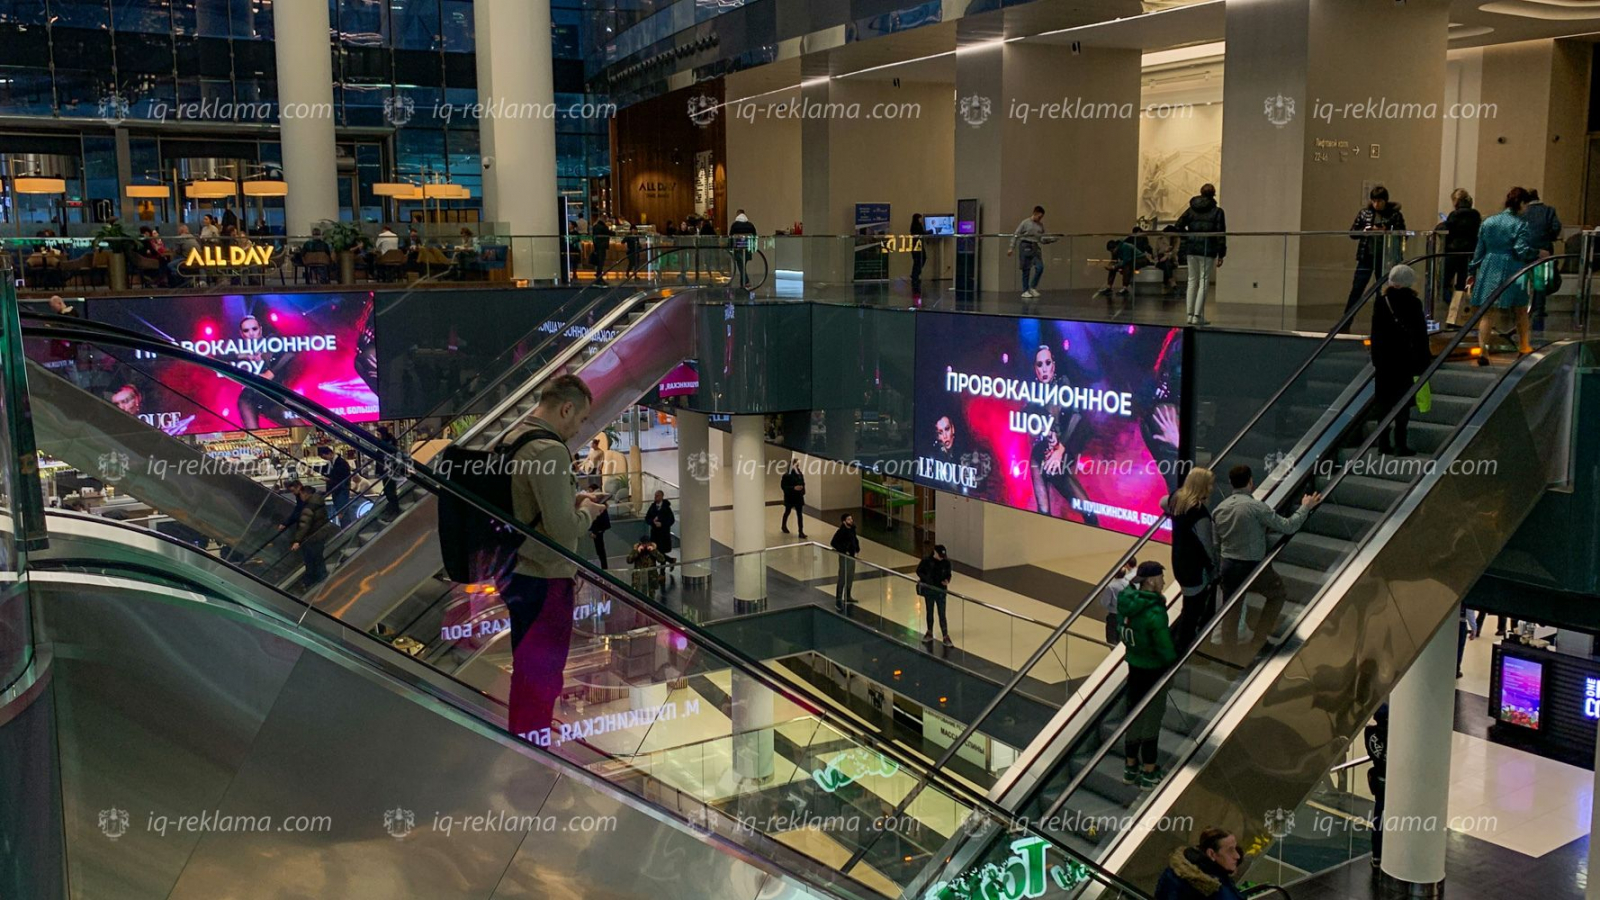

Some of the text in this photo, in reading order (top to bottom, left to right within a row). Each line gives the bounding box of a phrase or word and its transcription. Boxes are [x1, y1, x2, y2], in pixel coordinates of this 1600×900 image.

[657, 182, 677, 191] DY
[186, 245, 274, 266] ALL DAY
[135, 335, 336, 359] ВОКАЦИОННОЕ
[946, 371, 1132, 415] ПРОВОКАЦИОННОЕ
[1009, 410, 1055, 436] ШОУ
[919, 456, 978, 489] LE ROUGE
[1585, 677, 1596, 697] ONE
